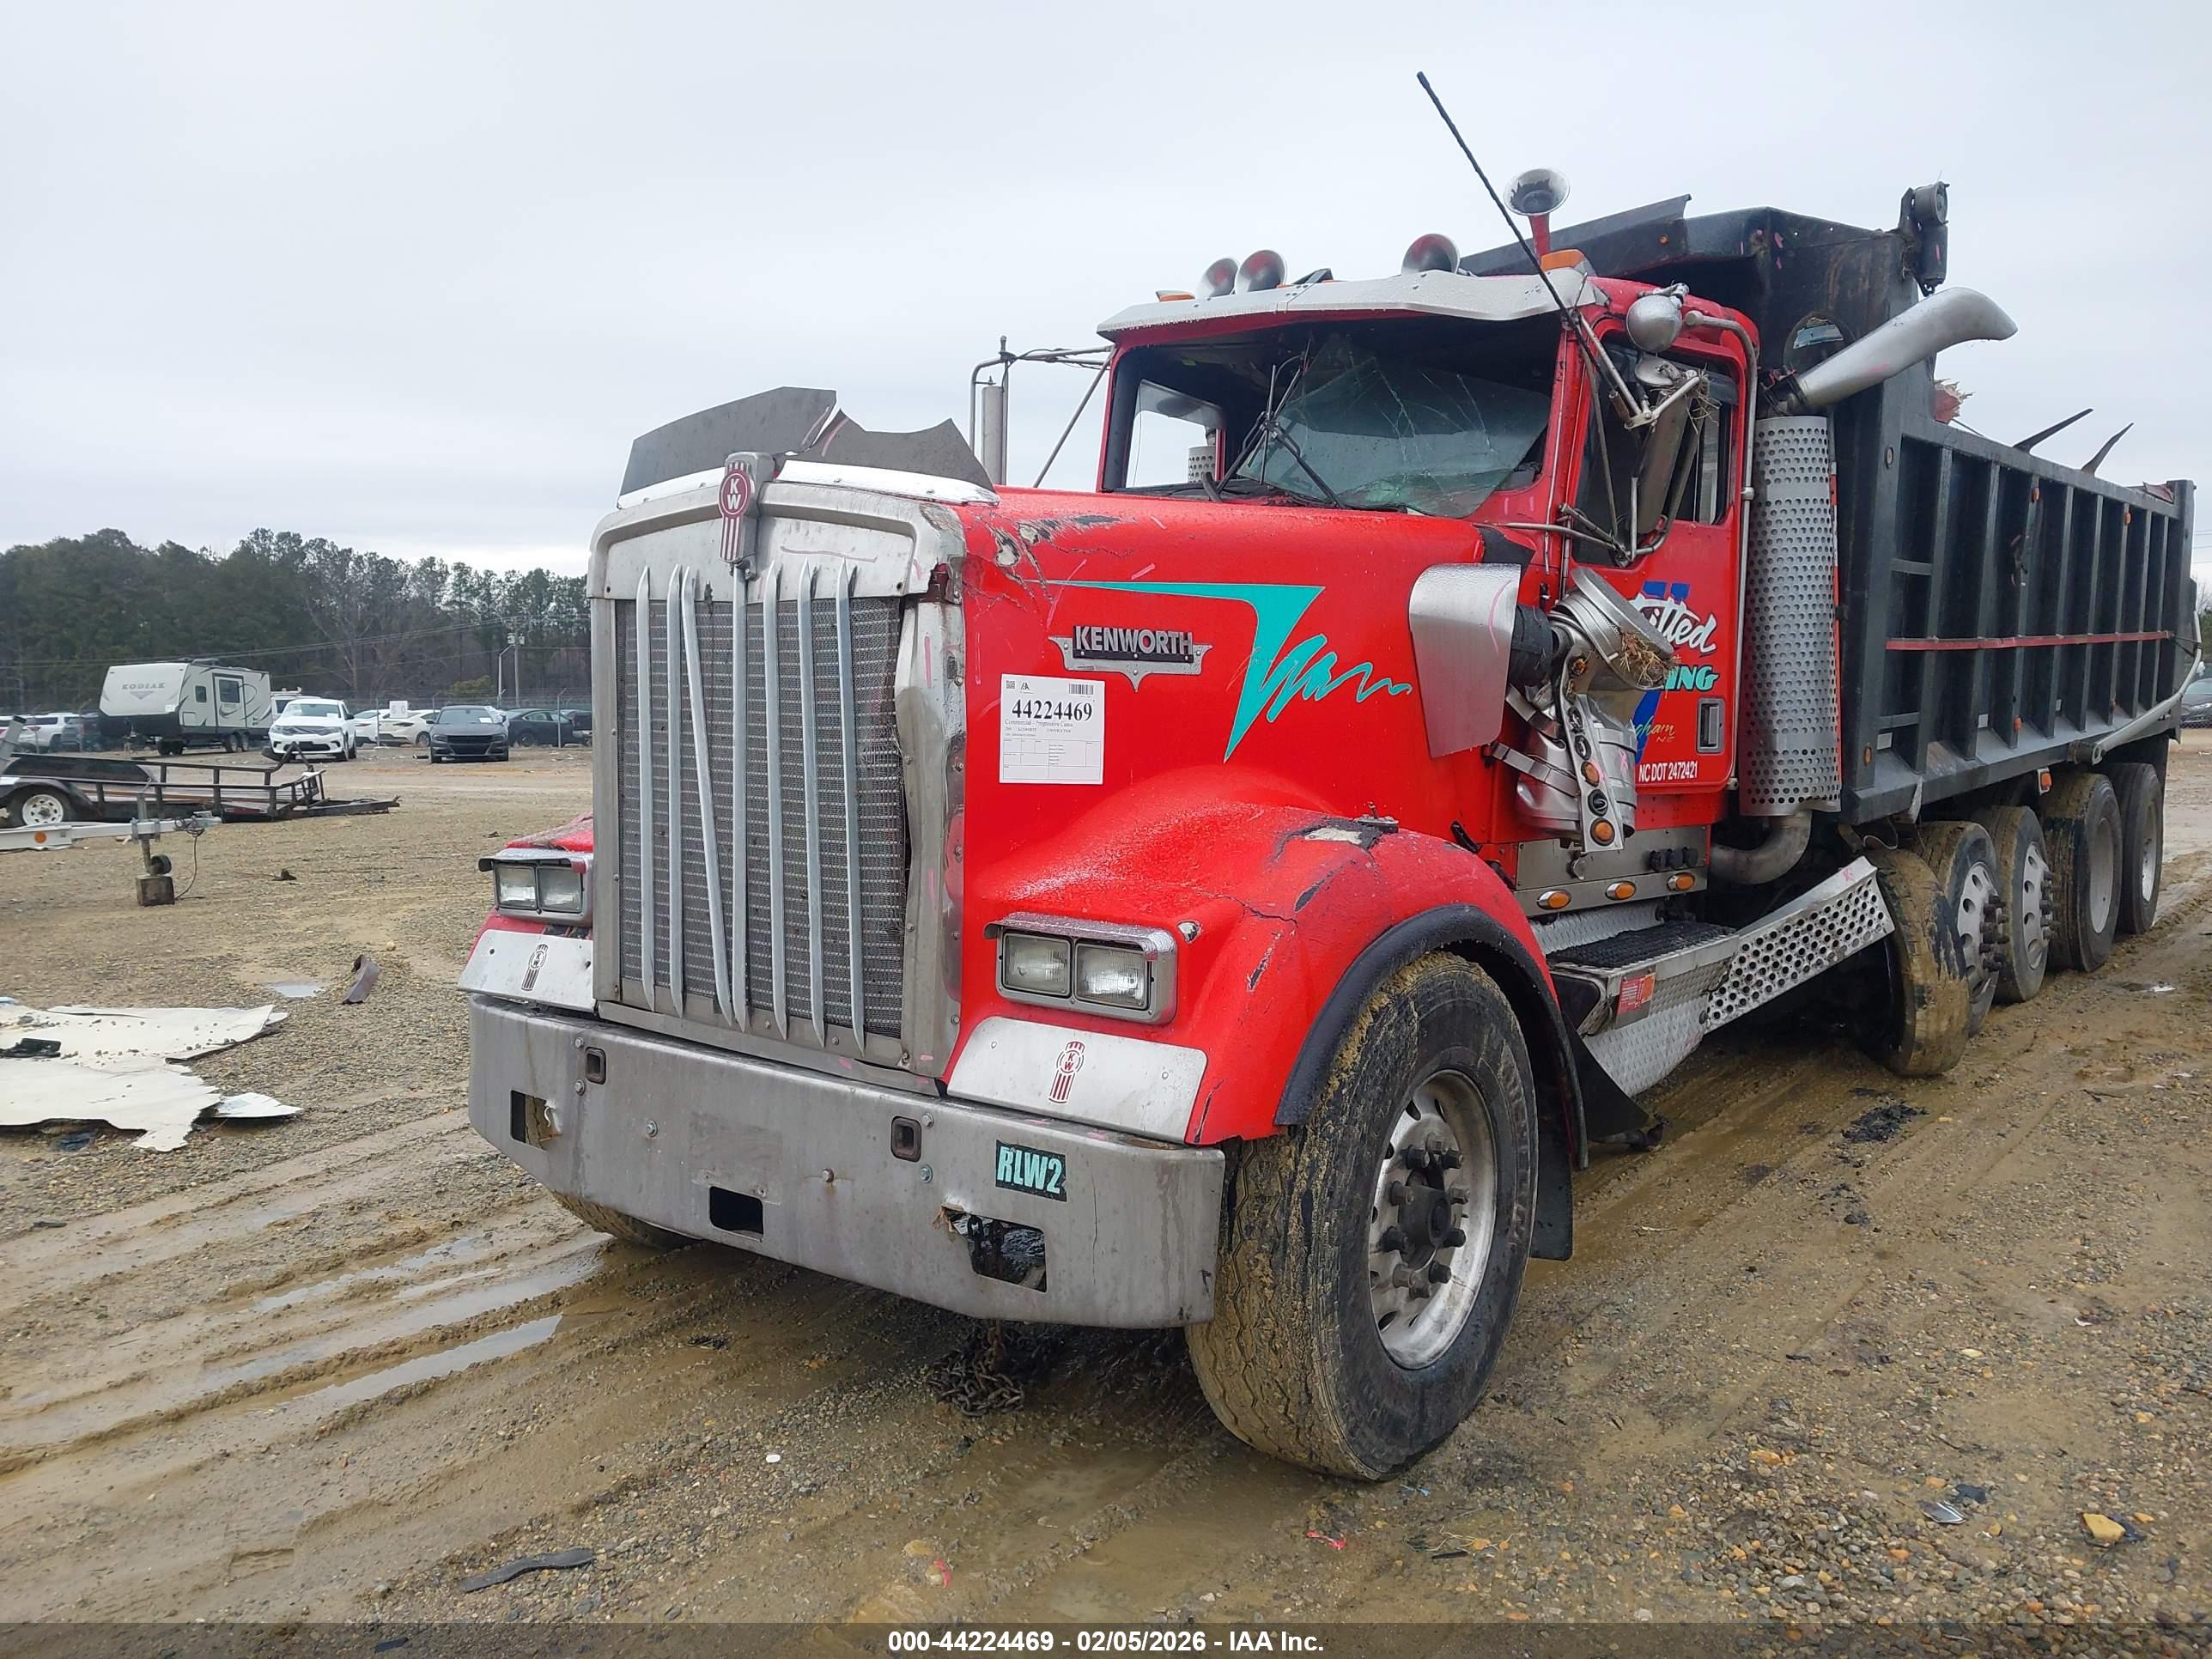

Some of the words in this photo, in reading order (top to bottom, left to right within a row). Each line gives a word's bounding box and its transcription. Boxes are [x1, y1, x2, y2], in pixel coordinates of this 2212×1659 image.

[1076, 626, 1193, 655] KENWORTH
[1012, 699, 1092, 721] 44224469
[1638, 763, 1650, 782] NC
[1651, 763, 1668, 781] DOT
[1668, 761, 1698, 781] 2472421
[997, 1146, 1062, 1194] RLW2
